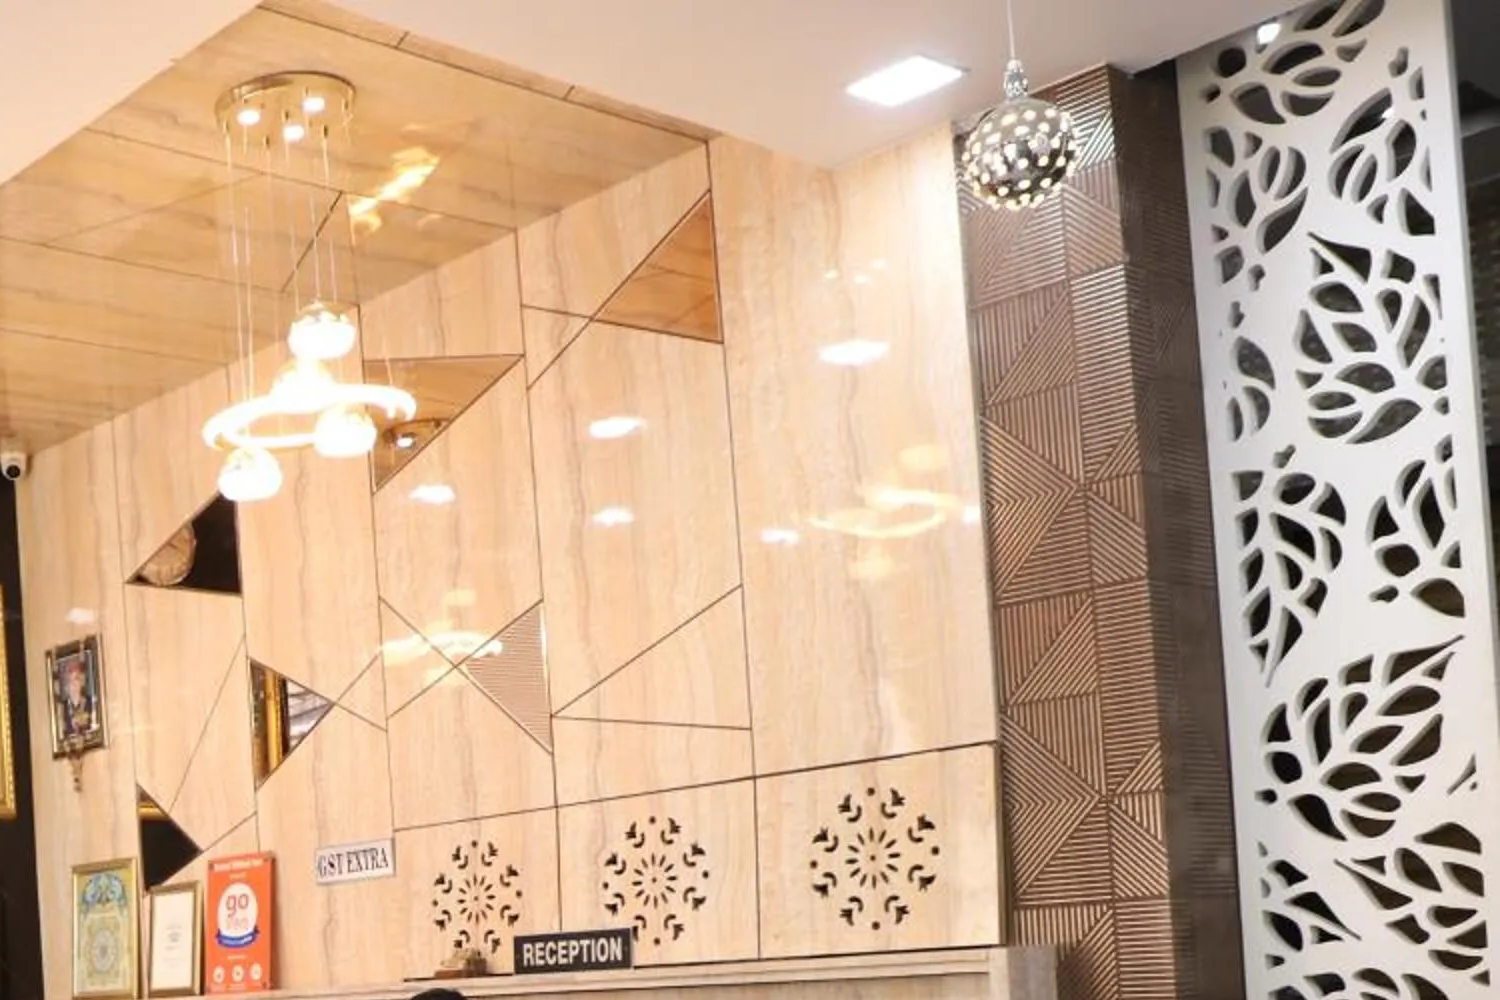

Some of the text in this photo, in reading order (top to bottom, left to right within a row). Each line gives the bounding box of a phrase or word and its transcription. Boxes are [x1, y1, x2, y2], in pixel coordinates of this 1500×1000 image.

[318, 847, 389, 878] GST EXTRA
[226, 893, 249, 918] go
[523, 937, 623, 967] RECEPTION
